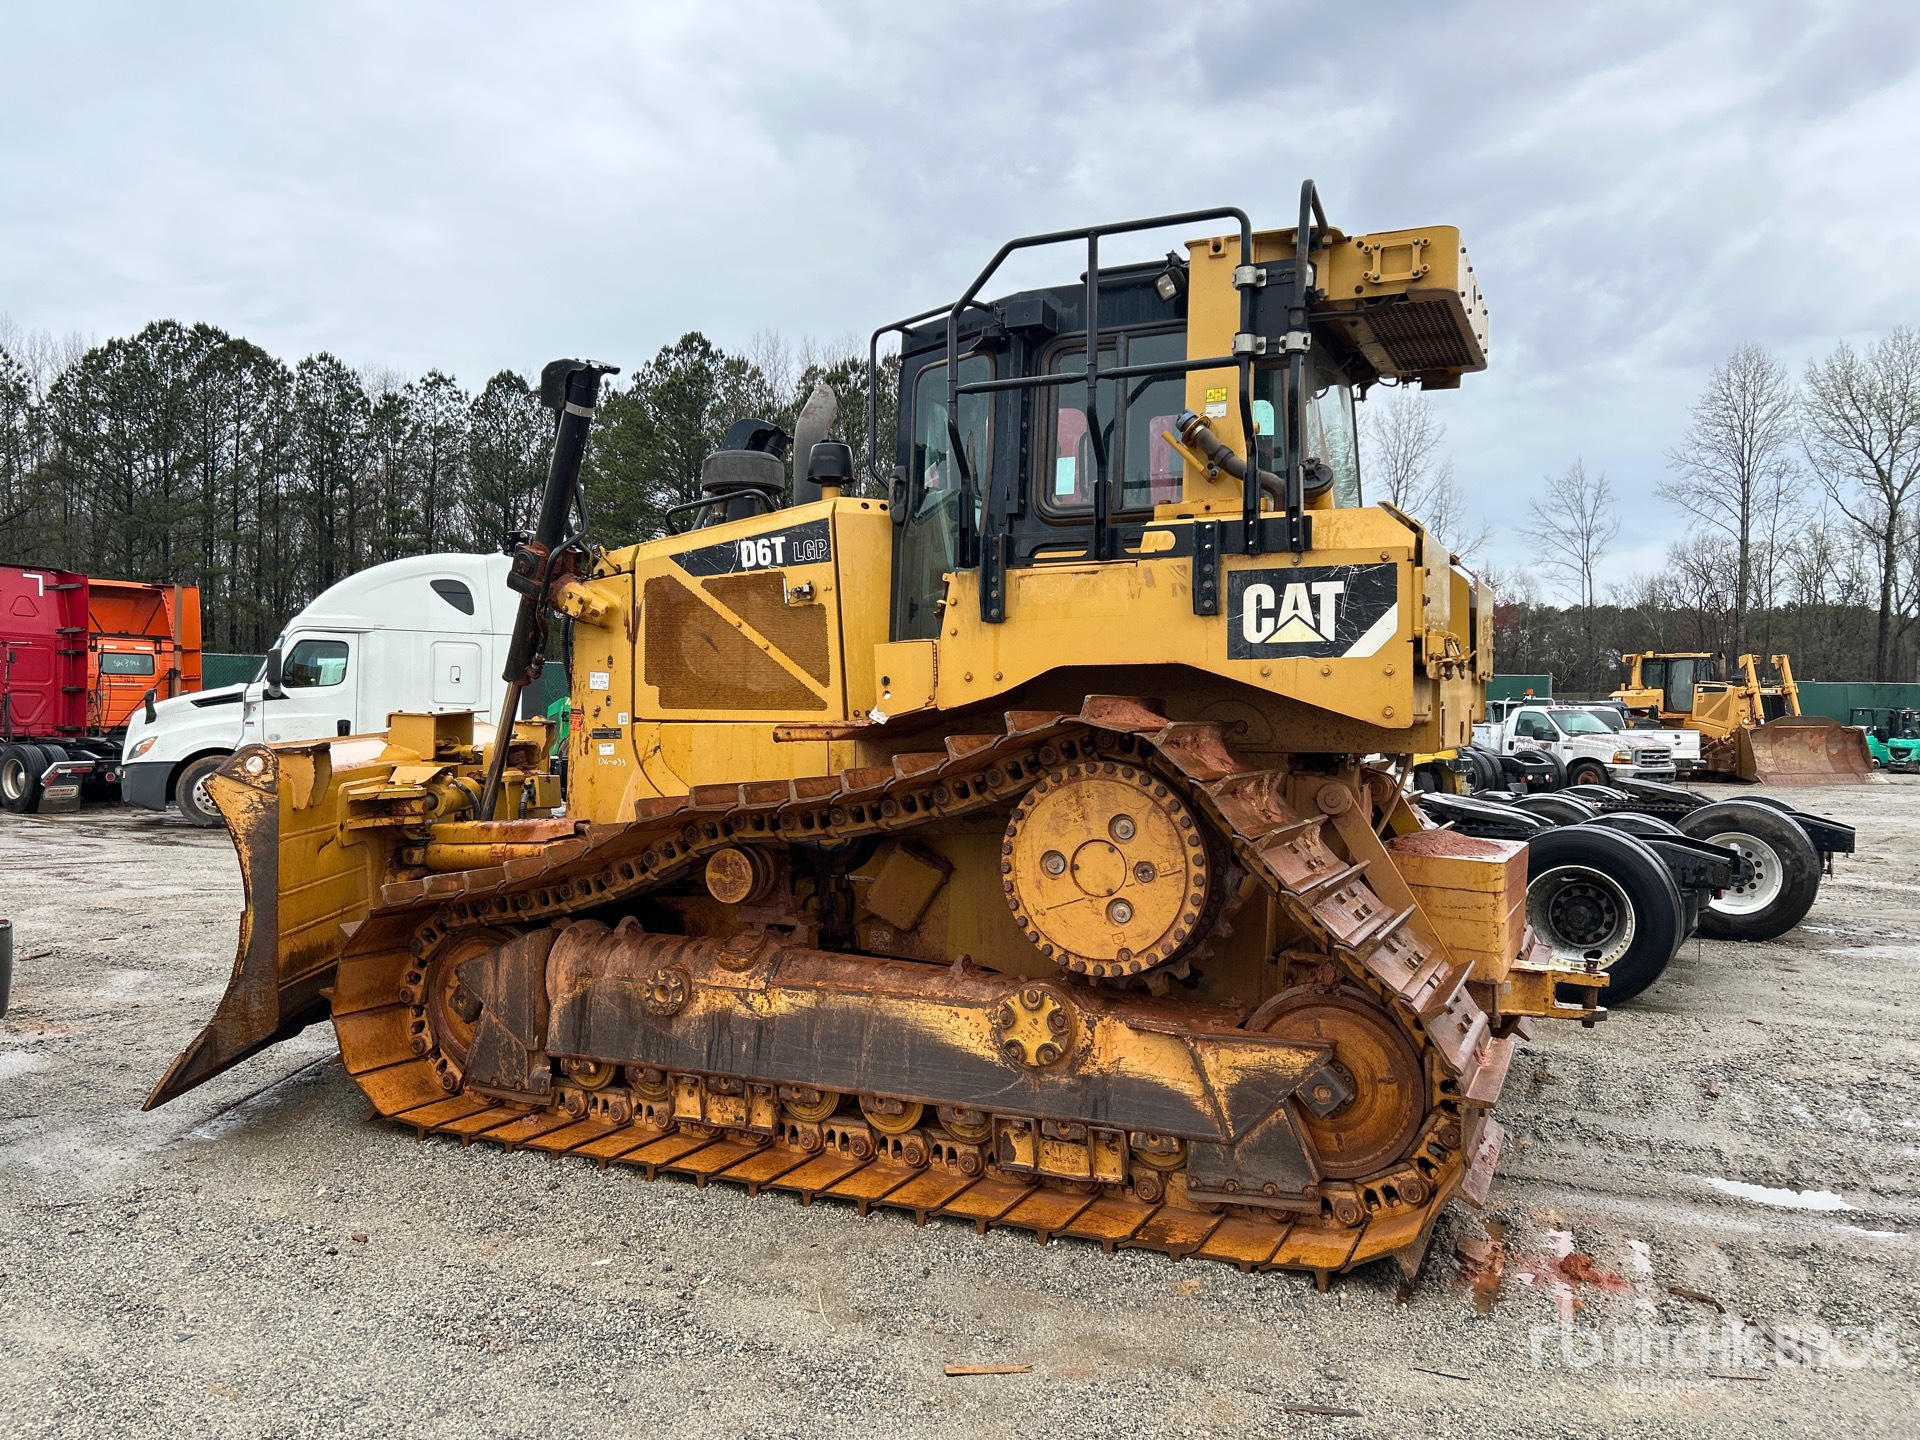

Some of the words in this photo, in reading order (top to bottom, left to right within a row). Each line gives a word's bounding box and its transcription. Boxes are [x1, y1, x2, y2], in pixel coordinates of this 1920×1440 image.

[740, 536, 785, 568] D6T
[793, 538, 828, 562] LGP
[1243, 581, 1345, 644] CAT
